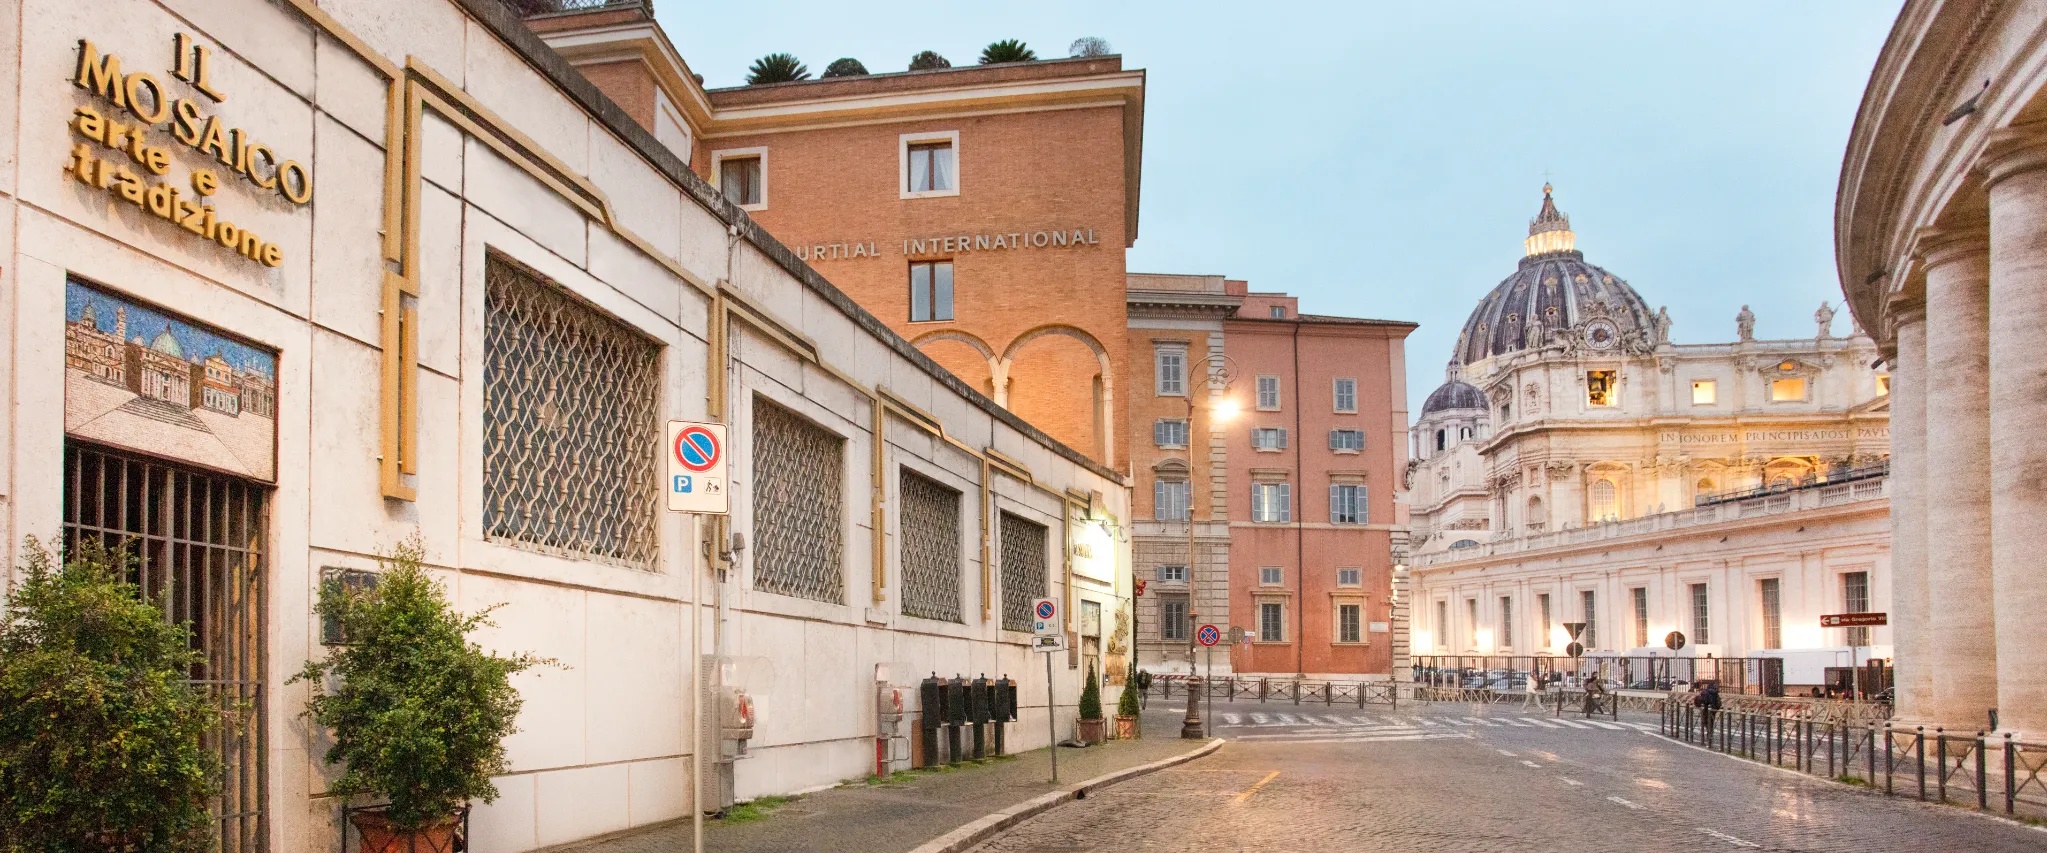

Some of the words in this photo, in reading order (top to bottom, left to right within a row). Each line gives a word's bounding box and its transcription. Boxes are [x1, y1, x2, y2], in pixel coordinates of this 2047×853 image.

[173, 32, 227, 102] IL
[73, 104, 170, 175] arte
[191, 168, 218, 196] e
[74, 39, 312, 204] MOSAICO
[71, 142, 283, 267] tradizione
[788, 241, 880, 260] URTIAL
[903, 229, 1099, 255] INTERNATIONAL
[1661, 433, 1675, 442] IN
[678, 477, 689, 491] P
